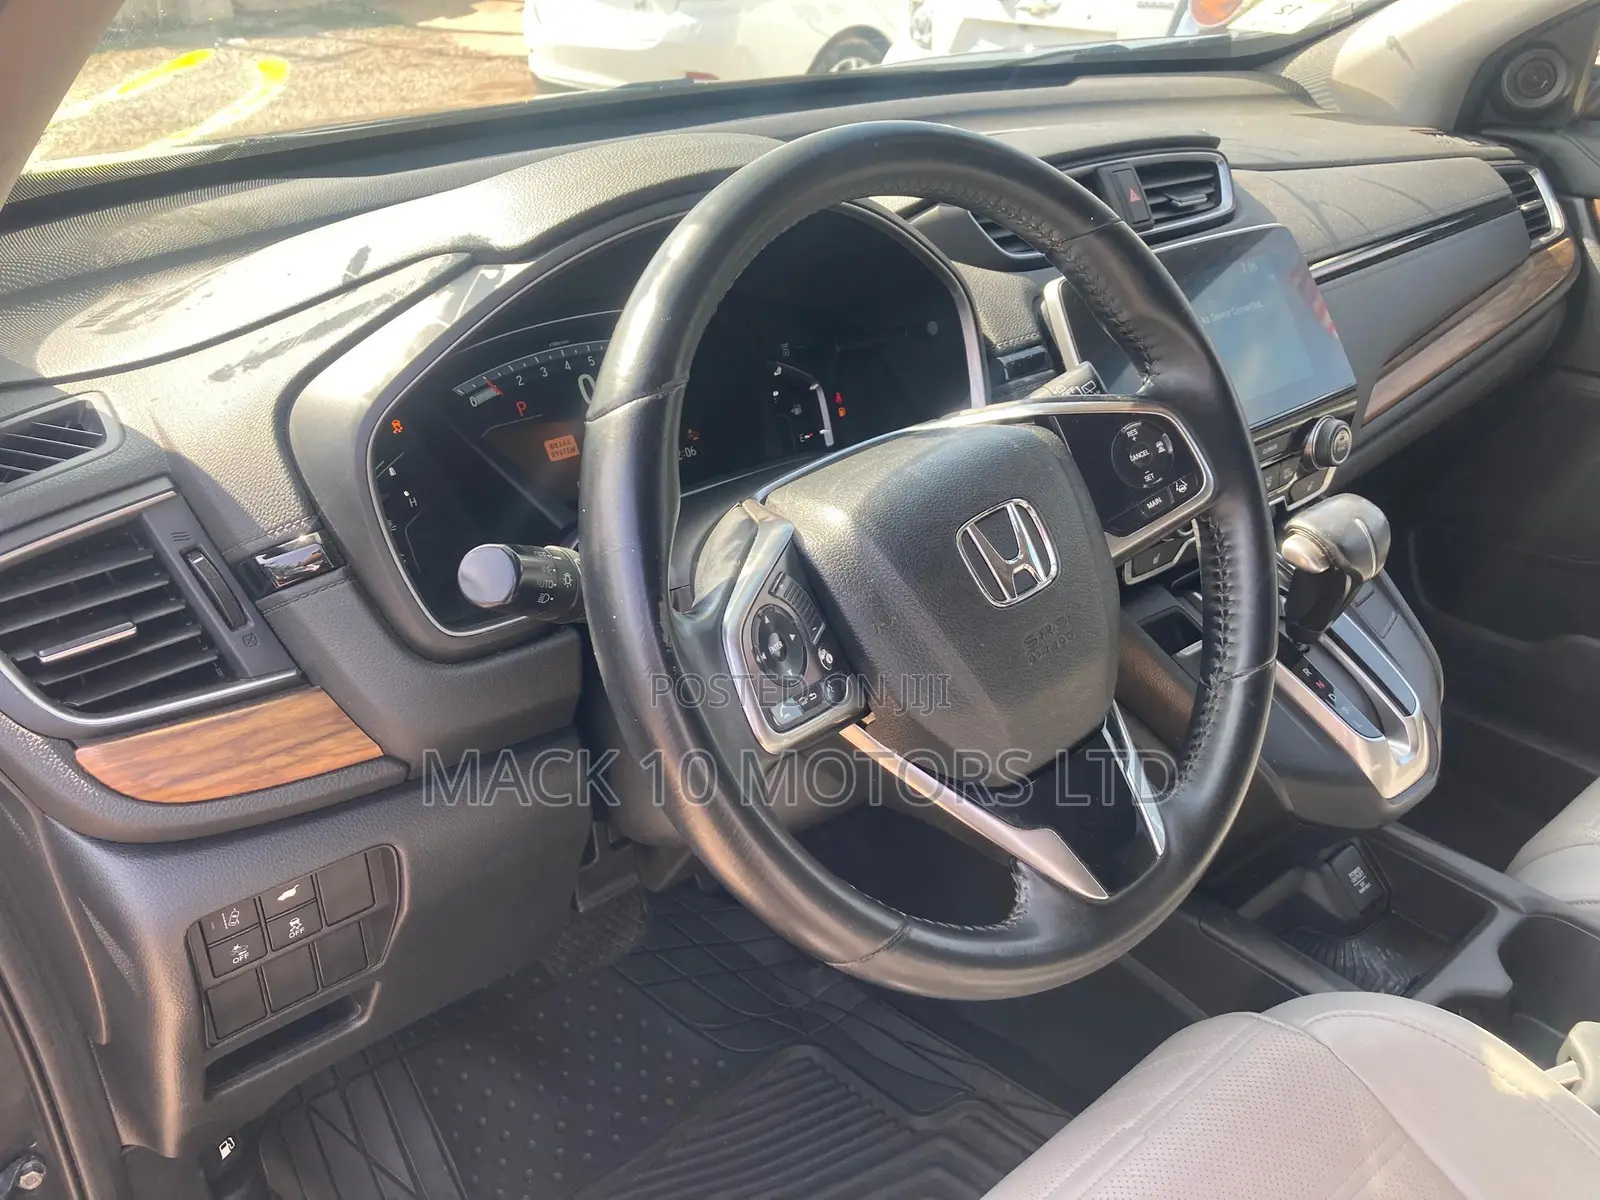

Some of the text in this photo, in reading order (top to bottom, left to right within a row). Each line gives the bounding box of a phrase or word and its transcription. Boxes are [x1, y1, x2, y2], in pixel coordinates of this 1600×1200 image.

[469, 356, 595, 407] 0 2 3 4 5
[516, 401, 527, 417] P
[1127, 428, 1138, 438] RES
[1129, 449, 1150, 462] CANCEL
[1144, 473, 1155, 482] SET
[409, 496, 418, 507] H
[1146, 496, 1162, 509] MAIN
[1302, 667, 1312, 677] R
[288, 926, 305, 939] OFF
[232, 952, 249, 964] OFF
